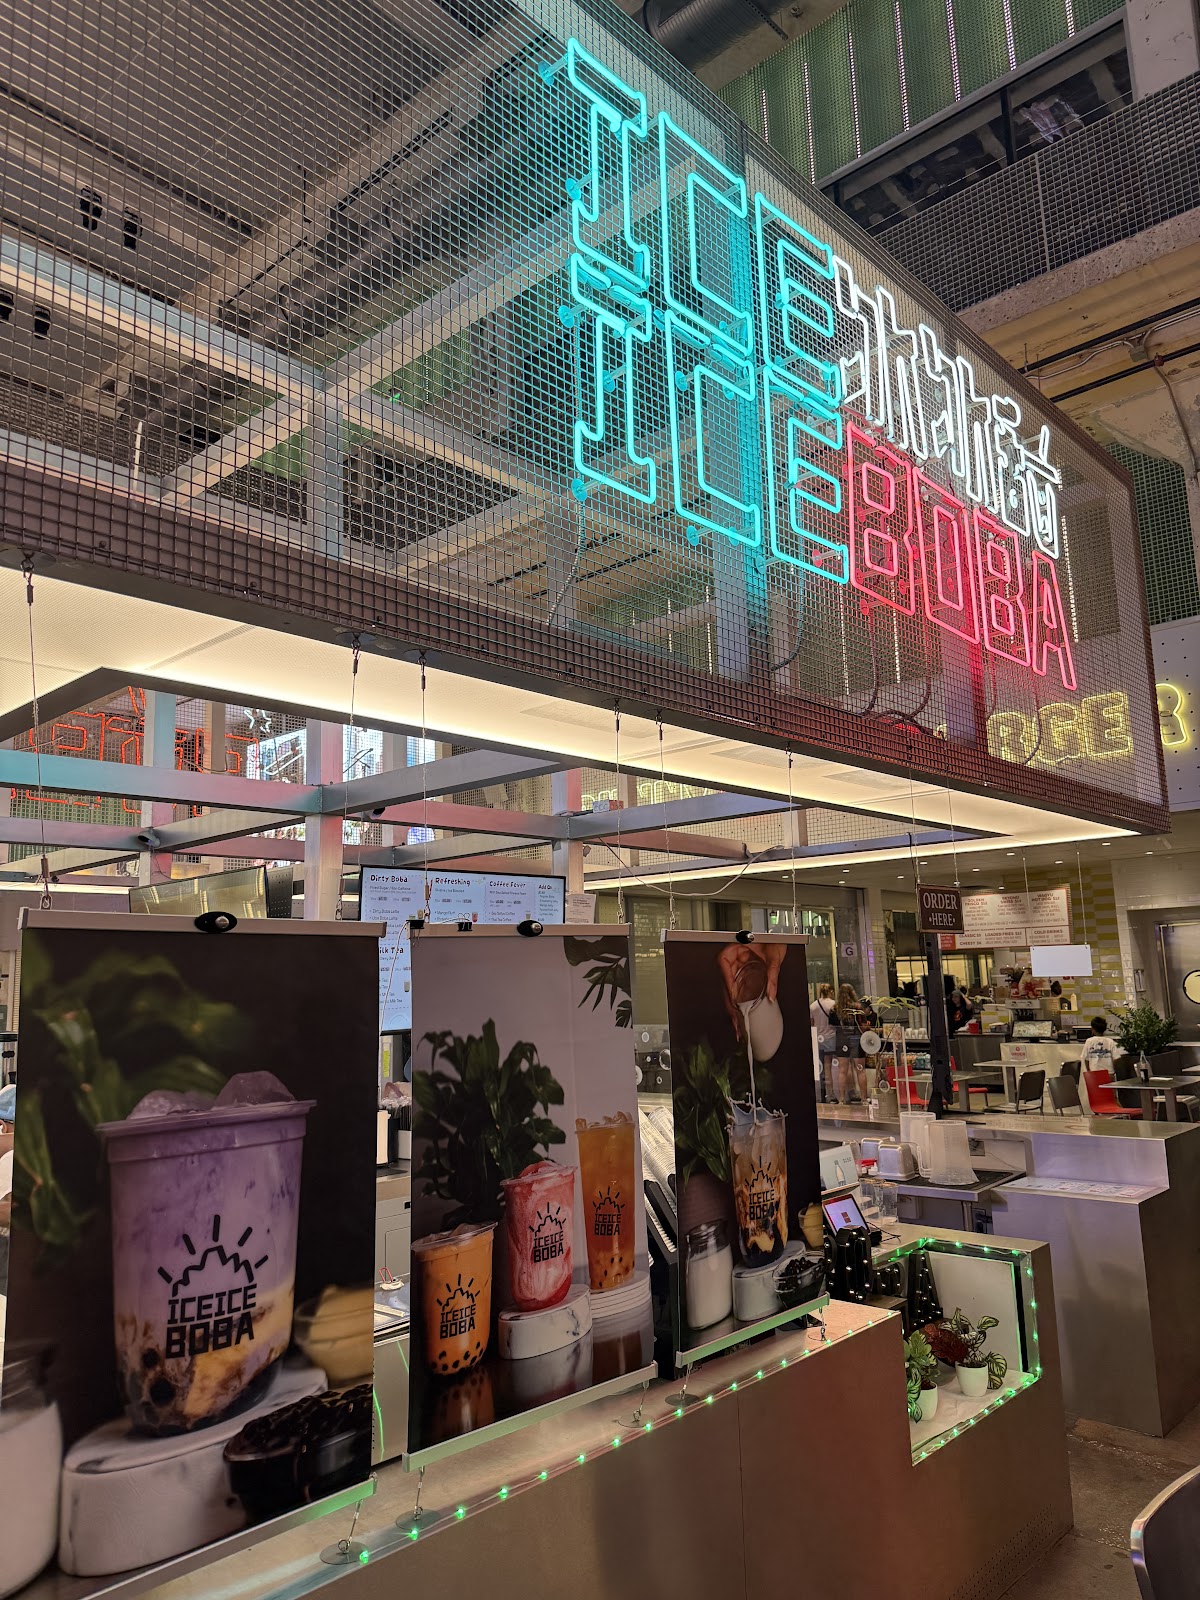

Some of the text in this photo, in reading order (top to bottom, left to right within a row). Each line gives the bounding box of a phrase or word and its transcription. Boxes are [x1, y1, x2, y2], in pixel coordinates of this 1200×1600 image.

[568, 36, 840, 408] ICE
[570, 252, 1077, 691] ICE BOBA
[370, 874, 408, 884] Dirty Boba
[434, 877, 471, 888] Refreshing
[489, 880, 527, 890] Coffee Fever
[923, 892, 958, 910] ORDER
[379, 946, 404, 954] ilk Tea
[846, 946, 854, 956] G
[748, 1202, 775, 1221] BOBA
[594, 1223, 621, 1236] BOBA
[533, 1242, 564, 1263] BOBA
[165, 1311, 254, 1359] BOBA
[440, 1316, 476, 1340] BOBA
